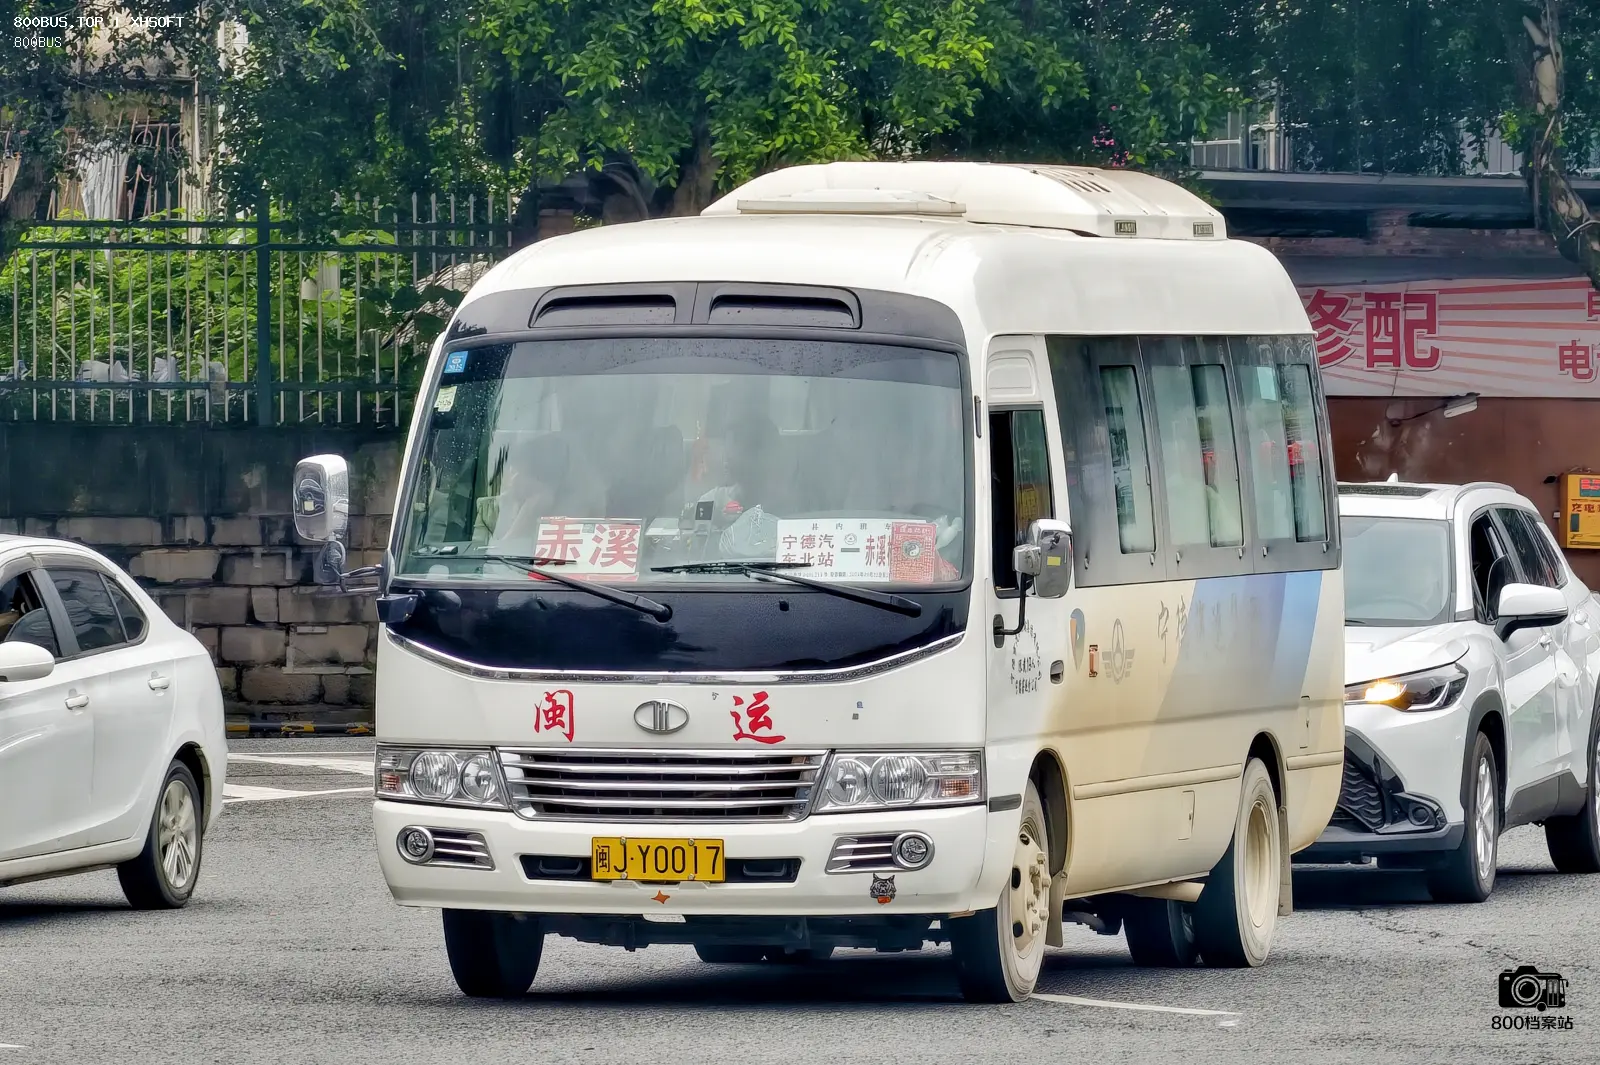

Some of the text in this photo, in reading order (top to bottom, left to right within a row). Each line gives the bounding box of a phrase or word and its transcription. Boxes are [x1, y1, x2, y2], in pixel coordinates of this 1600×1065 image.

[1571, 503, 1600, 513] 充电
[533, 520, 641, 568] 赤溪
[782, 533, 835, 550] 宁德汽
[534, 689, 787, 744] 闽 运
